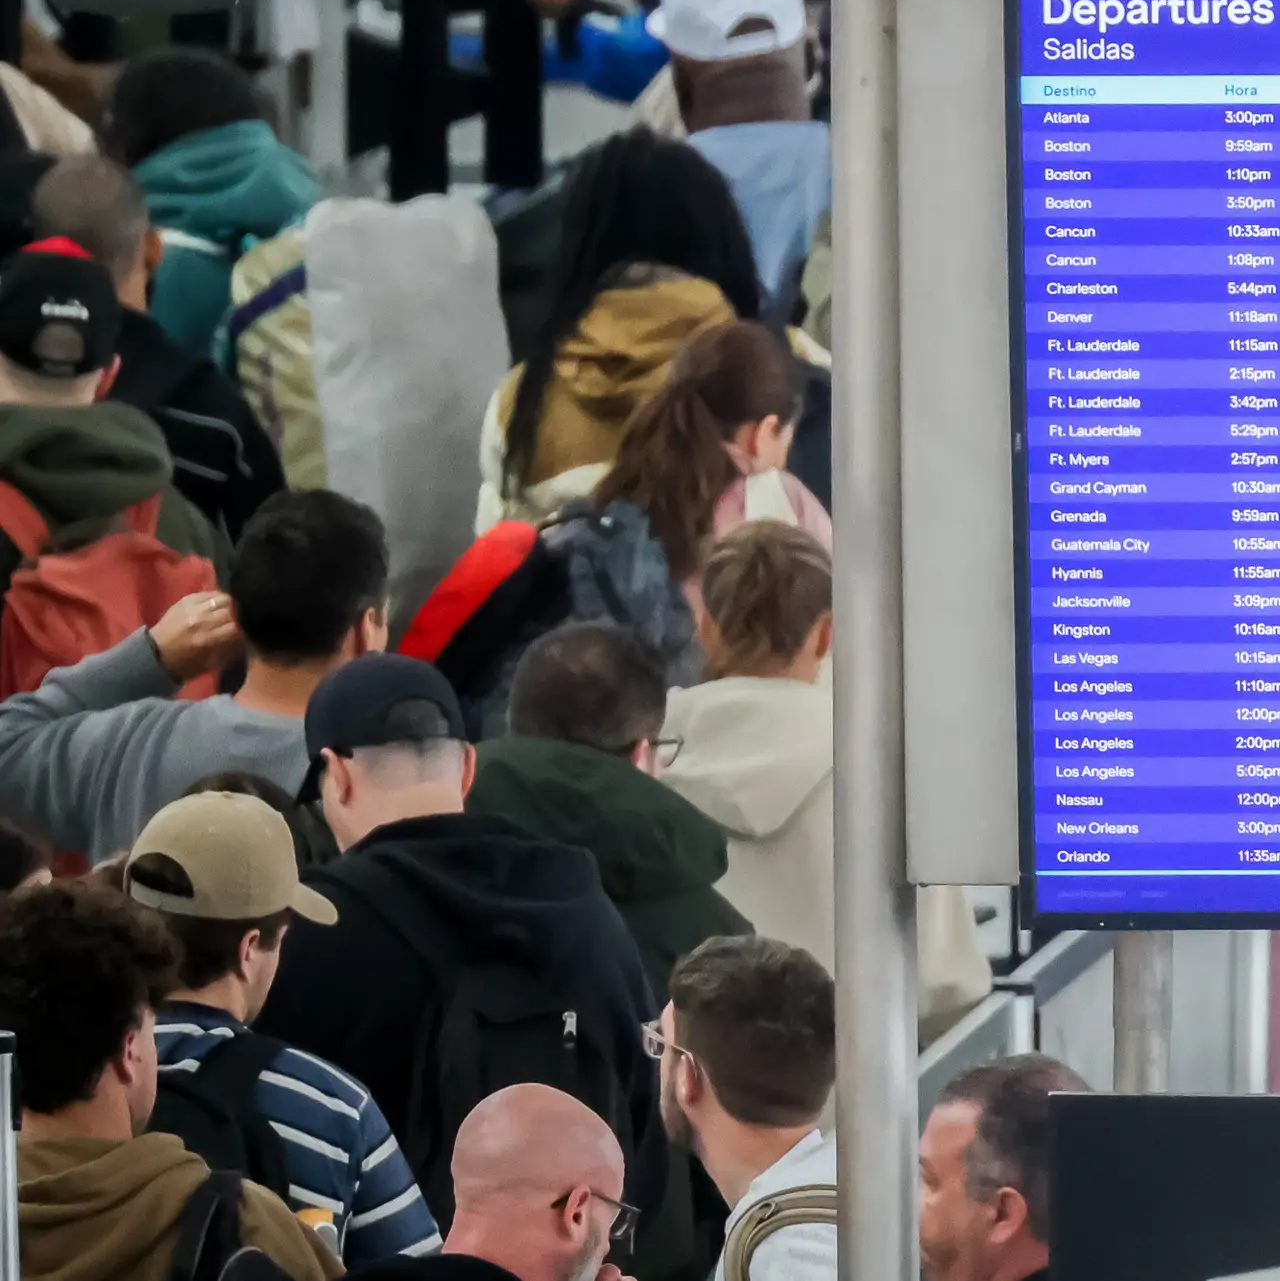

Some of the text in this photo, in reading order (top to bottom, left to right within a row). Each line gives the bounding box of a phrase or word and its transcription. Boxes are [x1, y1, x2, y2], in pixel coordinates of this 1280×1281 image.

[1044, 38, 1135, 60] Salidas
[1042, 84, 1097, 97] Destino
[1225, 84, 1258, 96] Hora
[1043, 112, 1090, 124] Atlanta
[1224, 110, 1274, 126] 3:00pm
[1054, 680, 1078, 692] Los
[1080, 680, 1133, 695] Angeles
